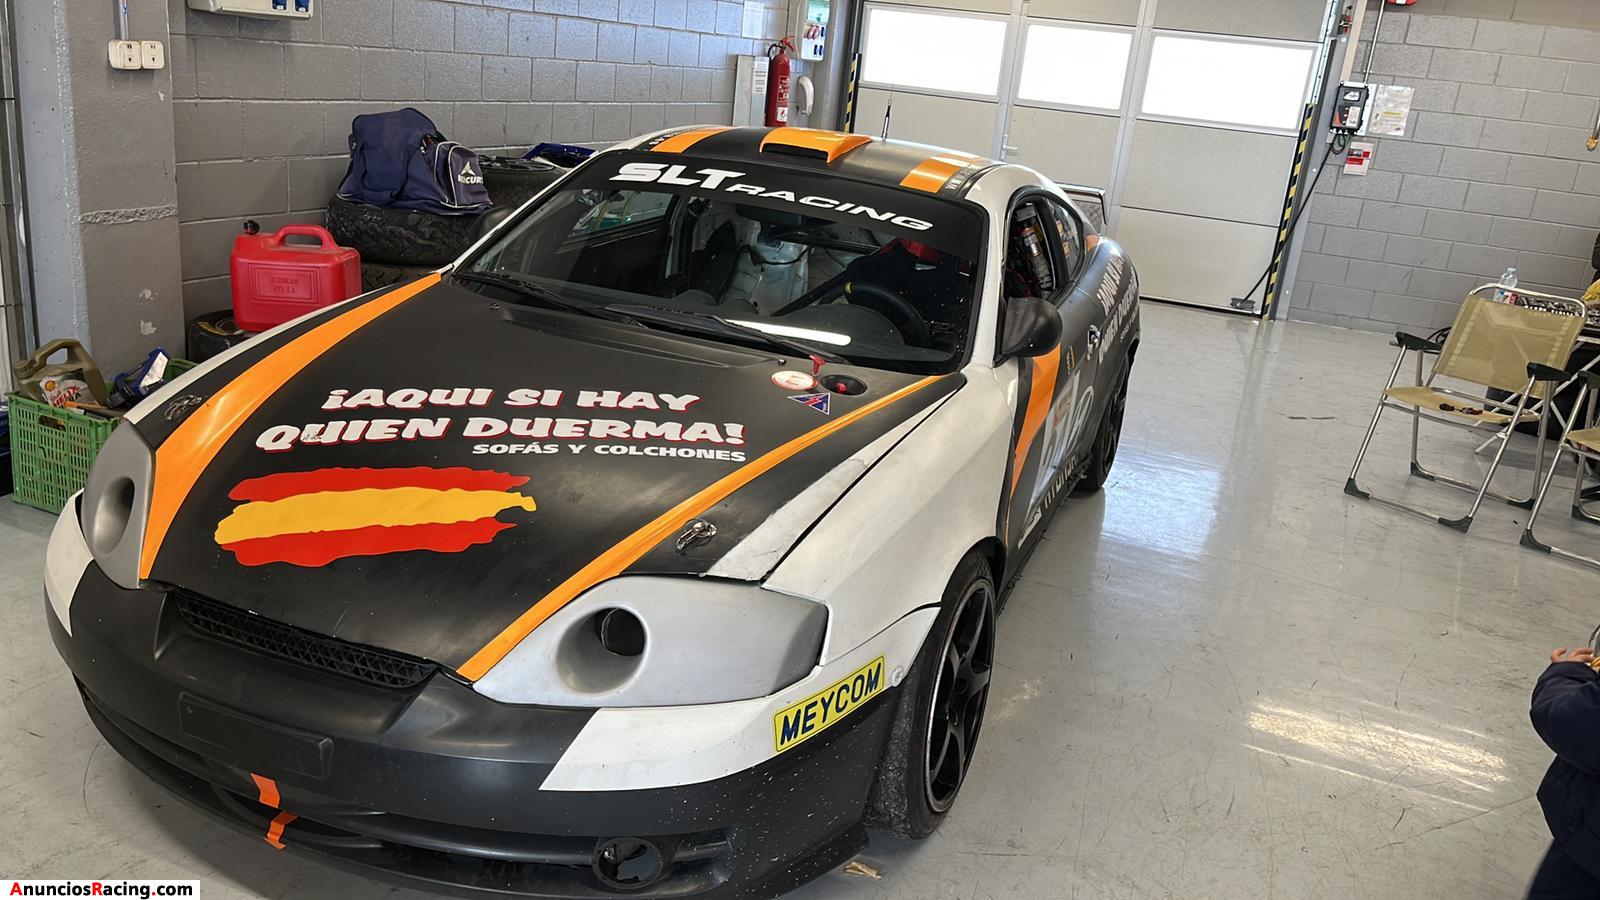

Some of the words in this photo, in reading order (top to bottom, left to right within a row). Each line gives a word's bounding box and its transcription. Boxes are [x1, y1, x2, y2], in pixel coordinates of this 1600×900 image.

[609, 163, 746, 189] SLT
[726, 183, 934, 231] RACING
[321, 388, 495, 411] ¡AQUI
[504, 388, 565, 409] SI
[576, 390, 700, 412] HAY
[255, 417, 452, 454] QUIEN
[462, 416, 748, 446] DUERMA!
[472, 441, 559, 455] SOFÁS
[569, 444, 588, 455] Y
[594, 445, 747, 463] COLCHONES
[780, 662, 882, 745] MEYCOM
